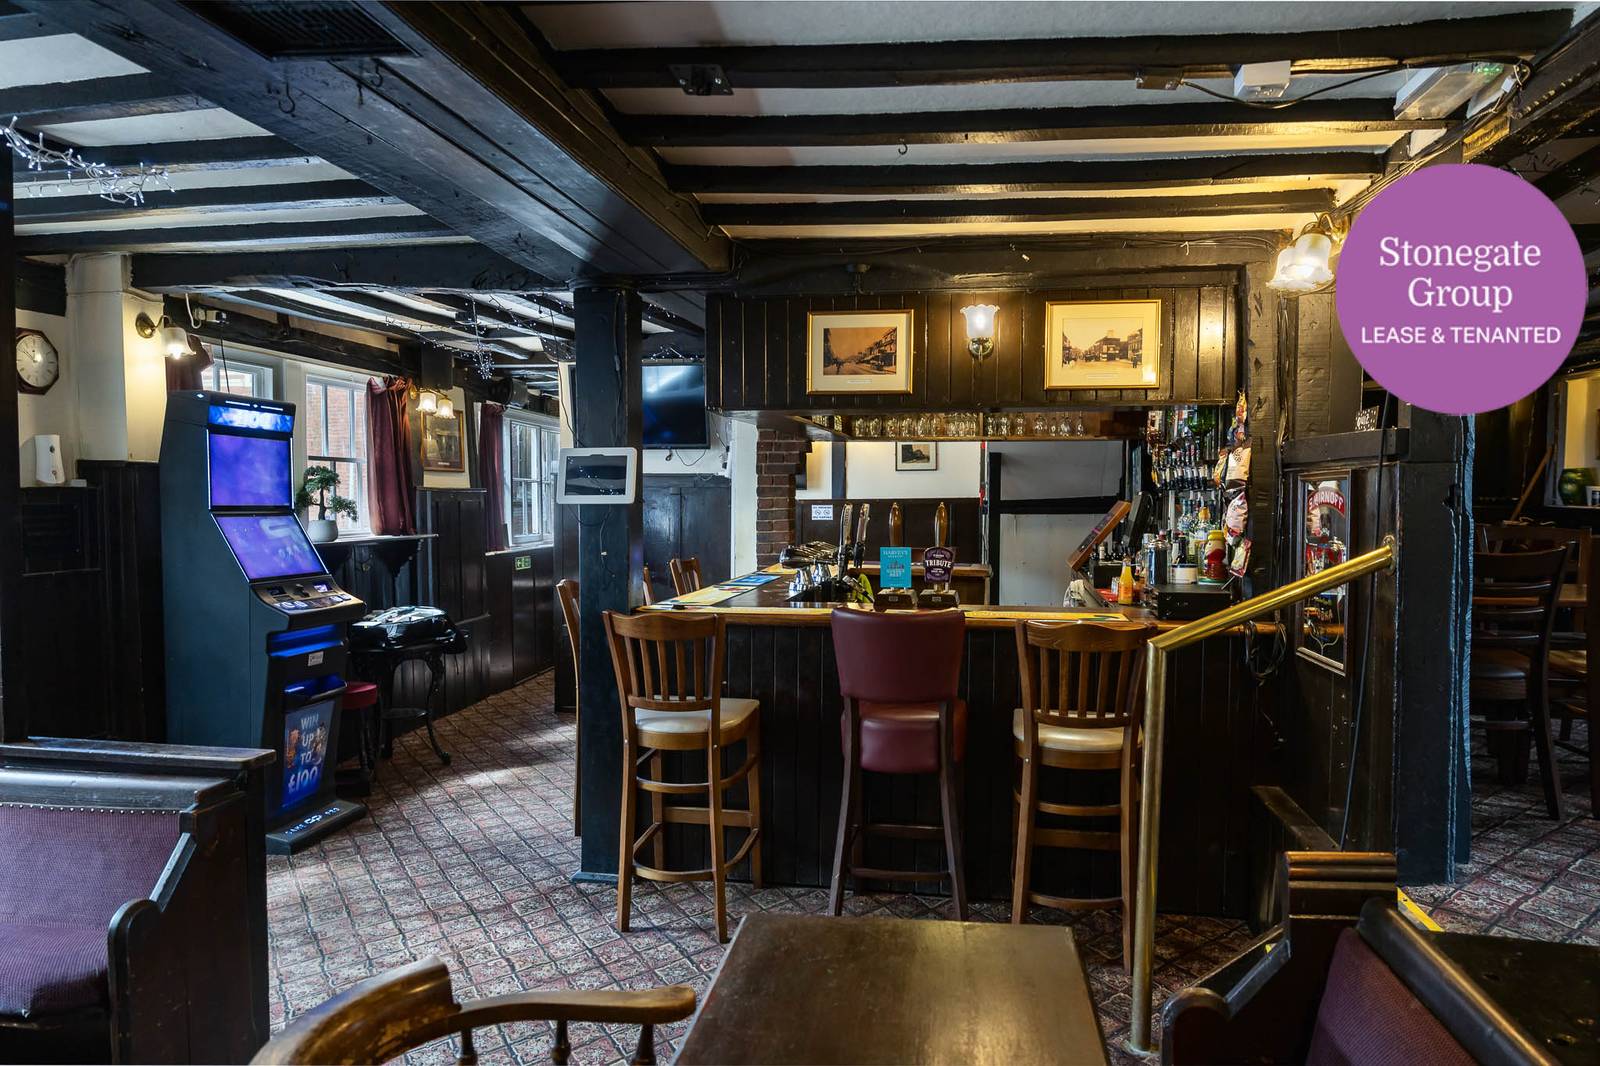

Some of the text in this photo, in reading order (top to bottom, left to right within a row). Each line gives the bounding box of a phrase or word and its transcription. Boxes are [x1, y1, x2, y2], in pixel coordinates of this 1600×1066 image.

[925, 559, 952, 568] TRIBUTE
[301, 714, 319, 730] WIN
[302, 733, 314, 747] UP
[300, 751, 312, 765] TO
[288, 766, 318, 794] £100
